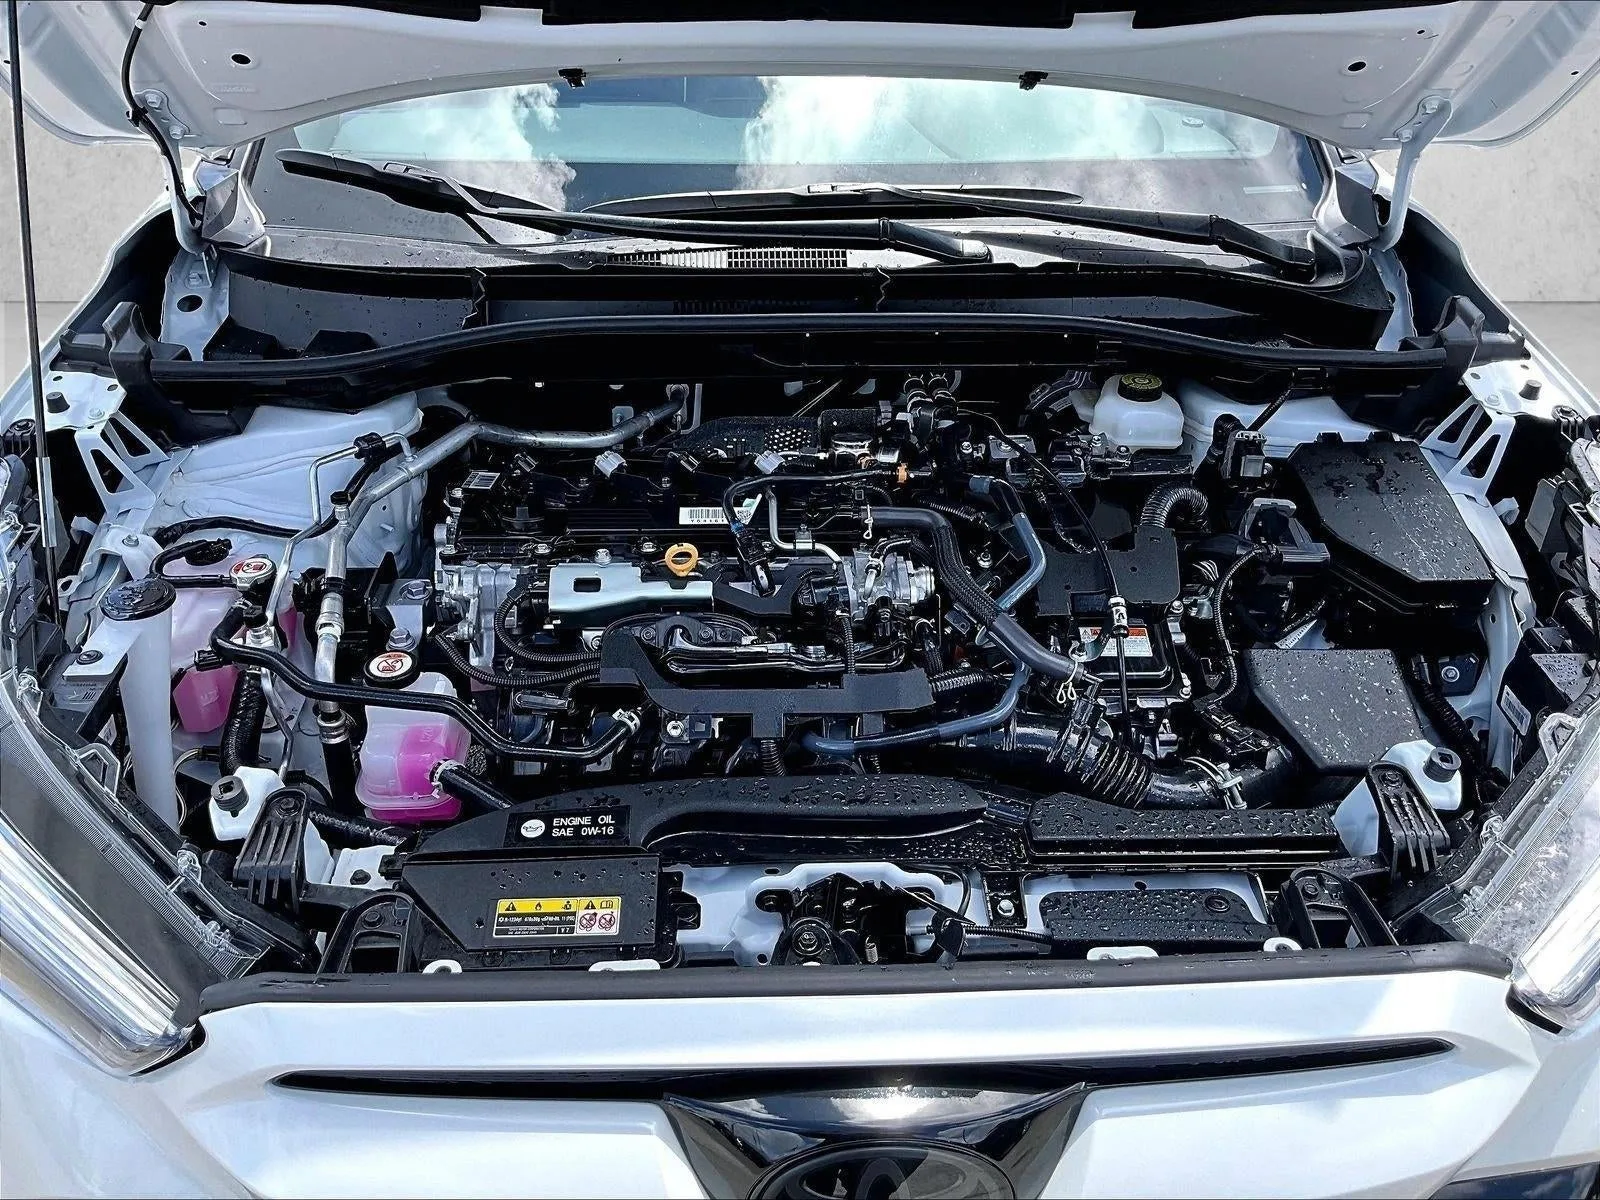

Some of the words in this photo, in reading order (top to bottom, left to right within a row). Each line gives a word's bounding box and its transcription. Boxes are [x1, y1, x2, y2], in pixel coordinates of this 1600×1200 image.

[552, 816, 592, 827] ENGINE
[597, 814, 615, 824] OIL
[552, 827, 574, 837] SAE
[581, 826, 615, 836] 0W-16
